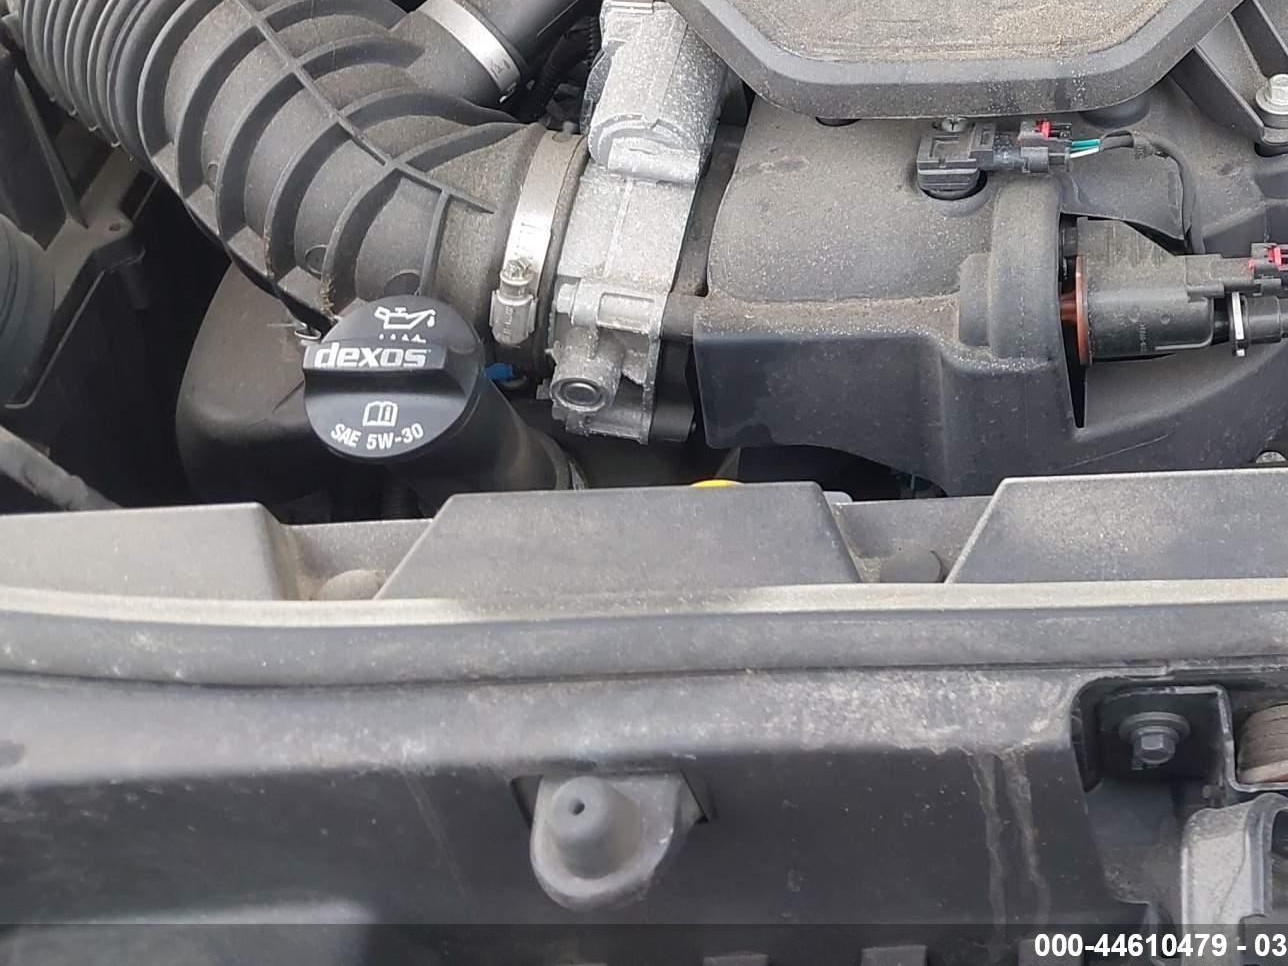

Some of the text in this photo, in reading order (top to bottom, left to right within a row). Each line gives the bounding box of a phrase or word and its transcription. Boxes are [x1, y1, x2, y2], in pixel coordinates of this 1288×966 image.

[313, 342, 428, 369] dexos
[330, 422, 425, 450] SAE 5W-30
